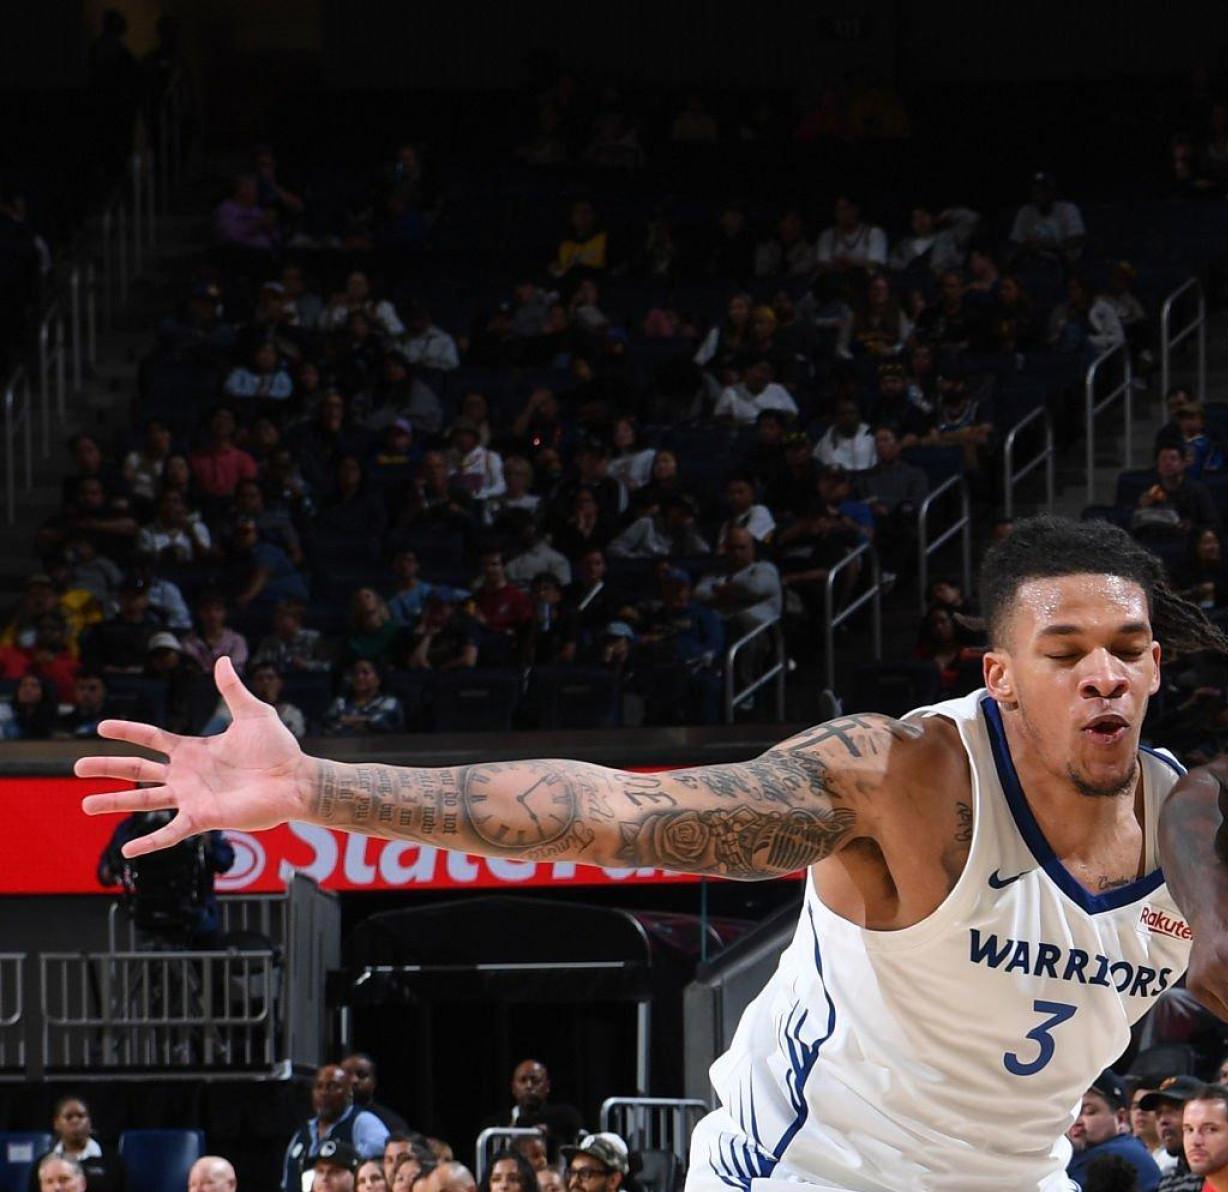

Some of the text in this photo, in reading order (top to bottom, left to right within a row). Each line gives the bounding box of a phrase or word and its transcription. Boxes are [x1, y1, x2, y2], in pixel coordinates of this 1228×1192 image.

[1140, 906, 1194, 940] Rakute
[969, 928, 1172, 997] WARRIORS
[1003, 999, 1078, 1077] 3
